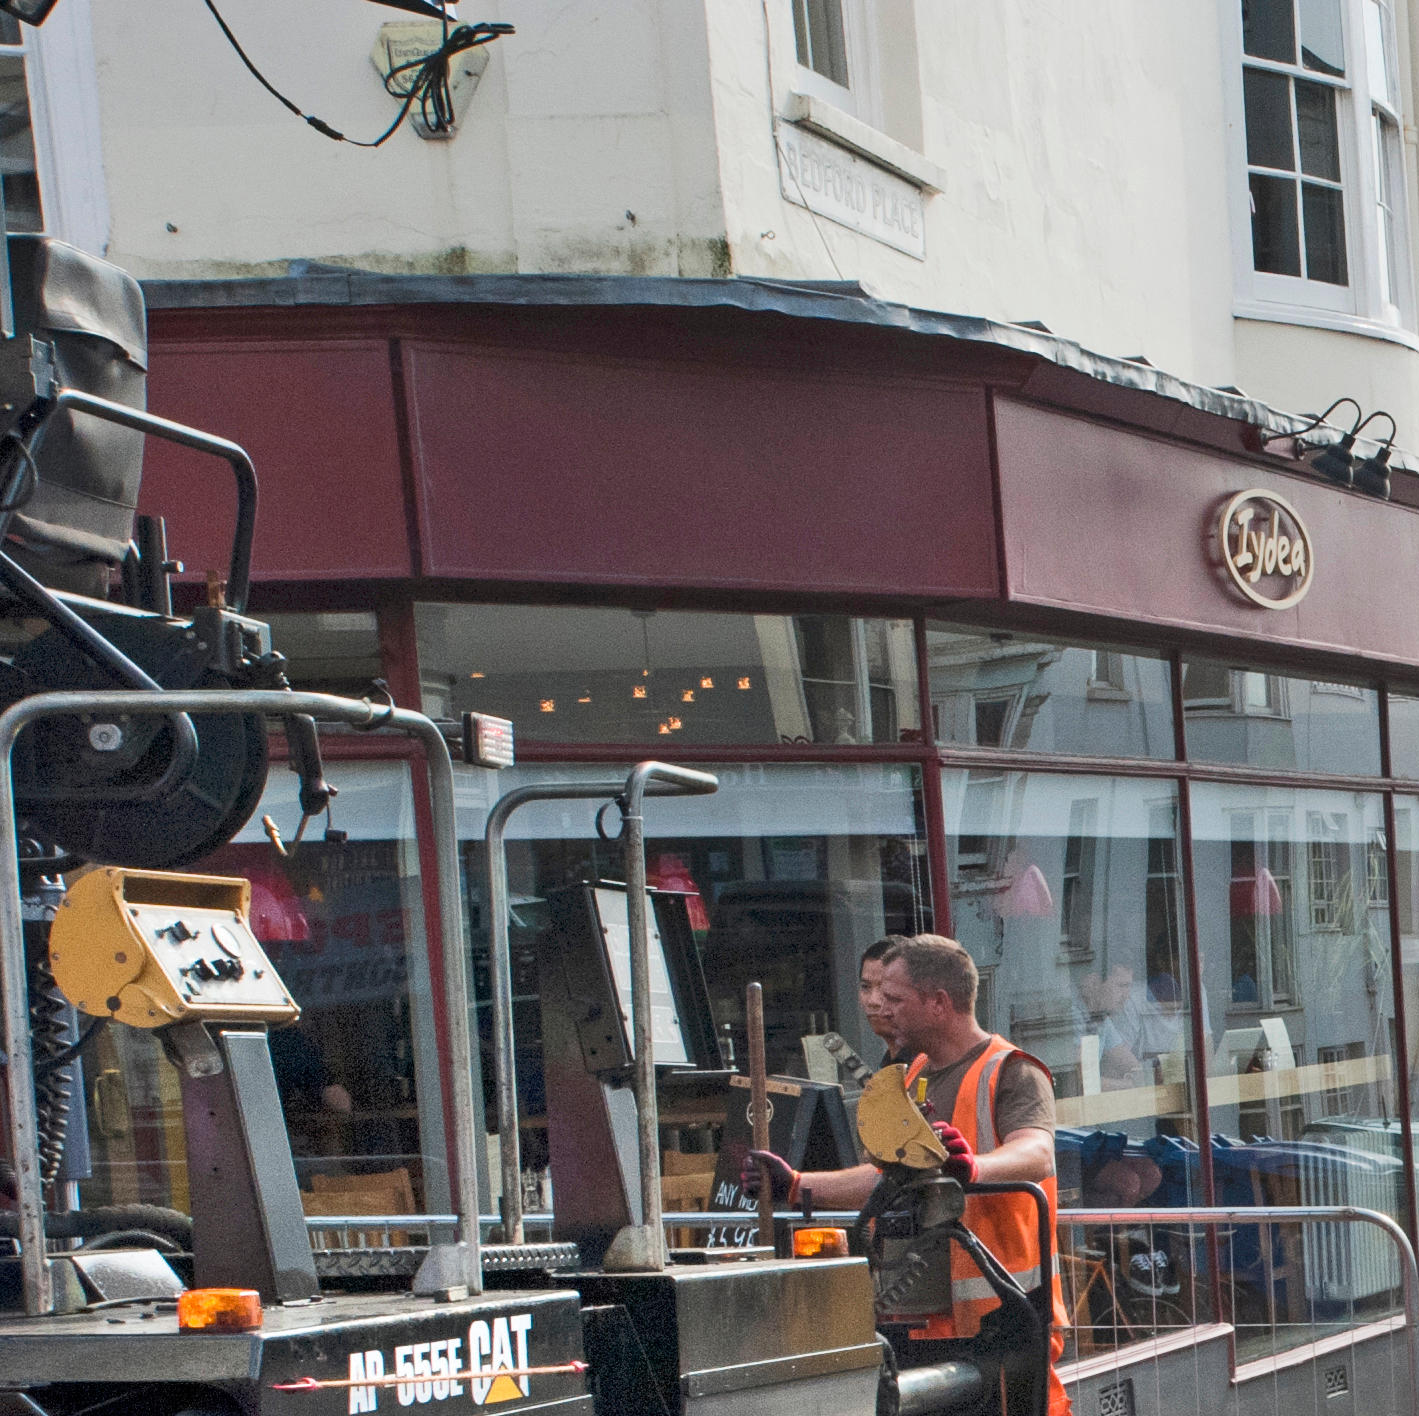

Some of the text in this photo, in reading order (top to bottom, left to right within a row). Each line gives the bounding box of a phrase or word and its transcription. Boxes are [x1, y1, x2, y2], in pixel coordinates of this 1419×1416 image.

[786, 142, 919, 240] BEDFORD PLACE
[1236, 507, 1306, 584] Iydea
[348, 1313, 533, 1415] AP-555E CAT
